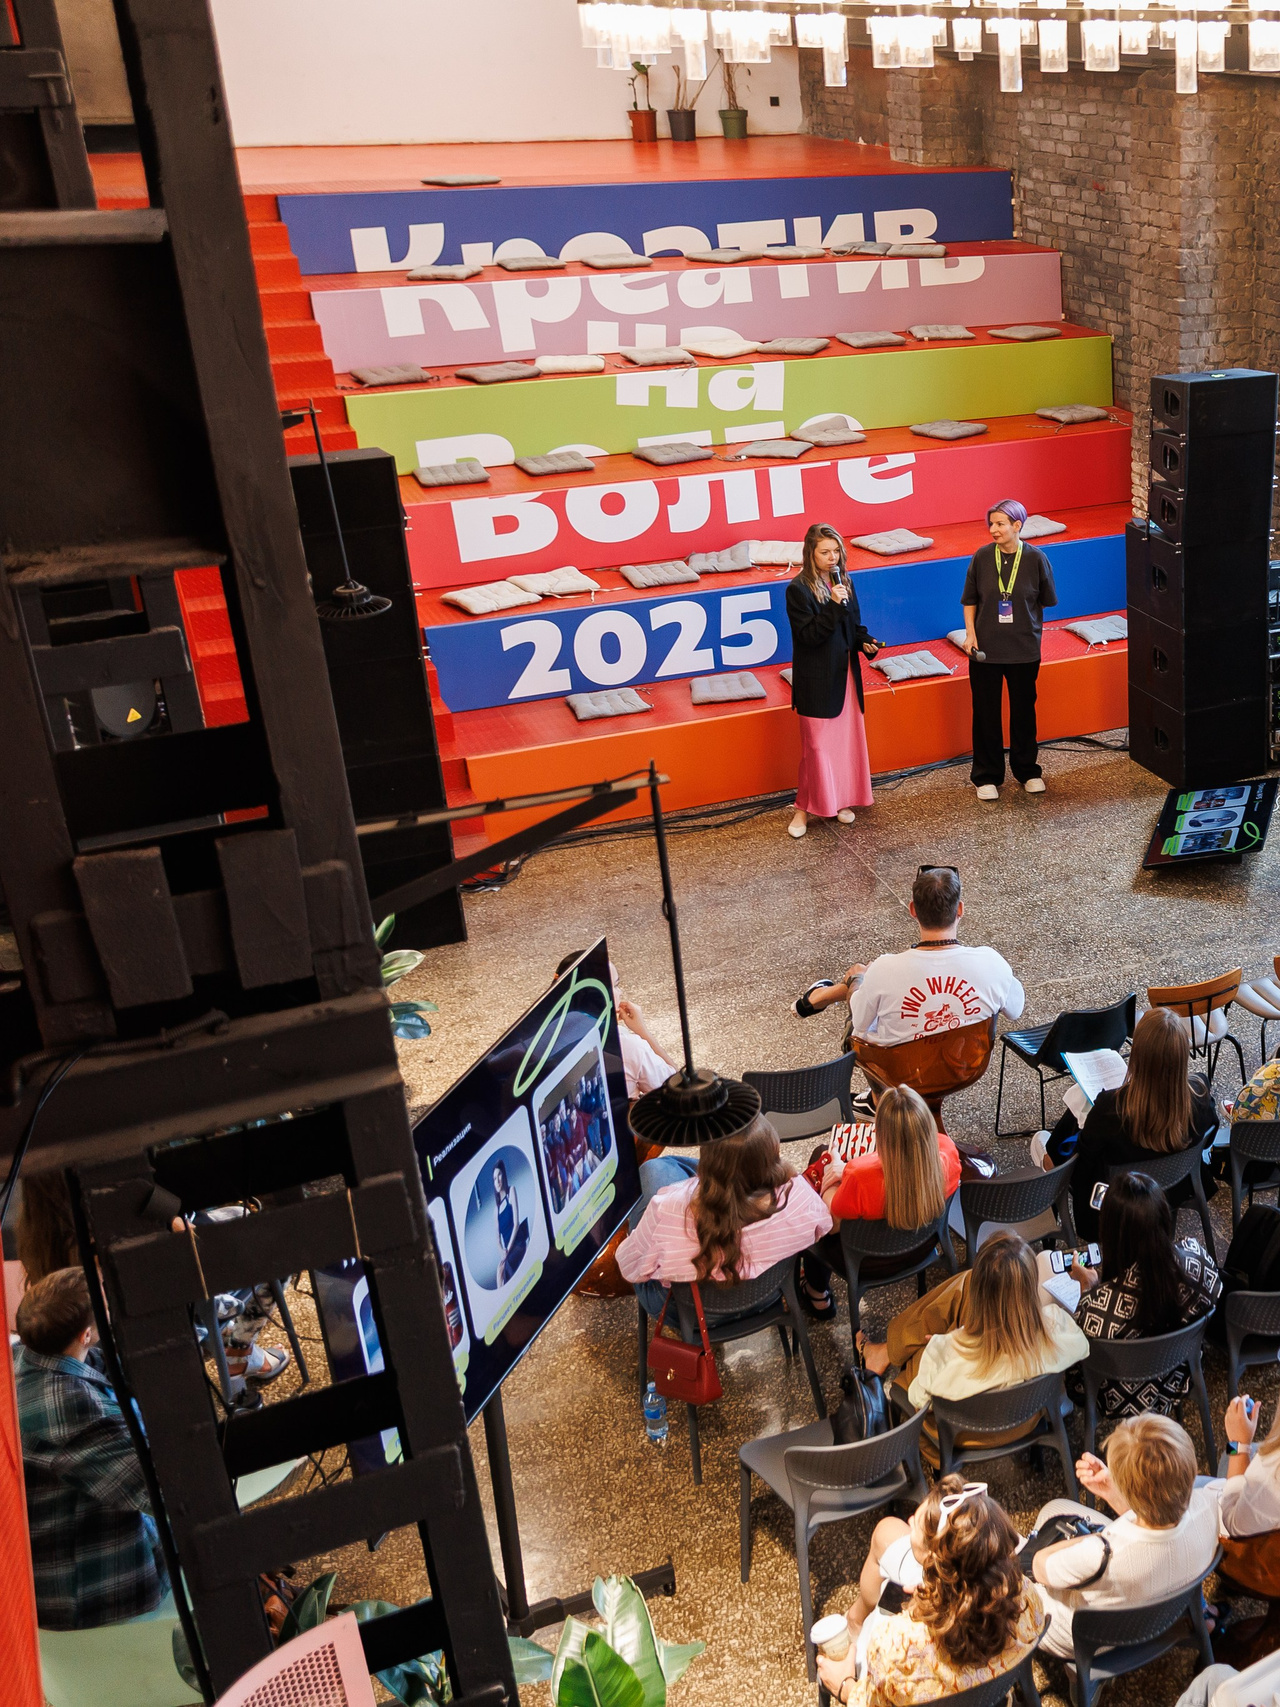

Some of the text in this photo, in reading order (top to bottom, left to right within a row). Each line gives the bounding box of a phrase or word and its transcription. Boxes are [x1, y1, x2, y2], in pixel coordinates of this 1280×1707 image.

[350, 208, 986, 353] Креатив
[587, 320, 785, 411] на
[416, 413, 915, 563] Волге
[500, 591, 778, 699] 2025
[901, 976, 981, 1019] TWO WHEELS
[433, 1122, 472, 1167] Реализация
